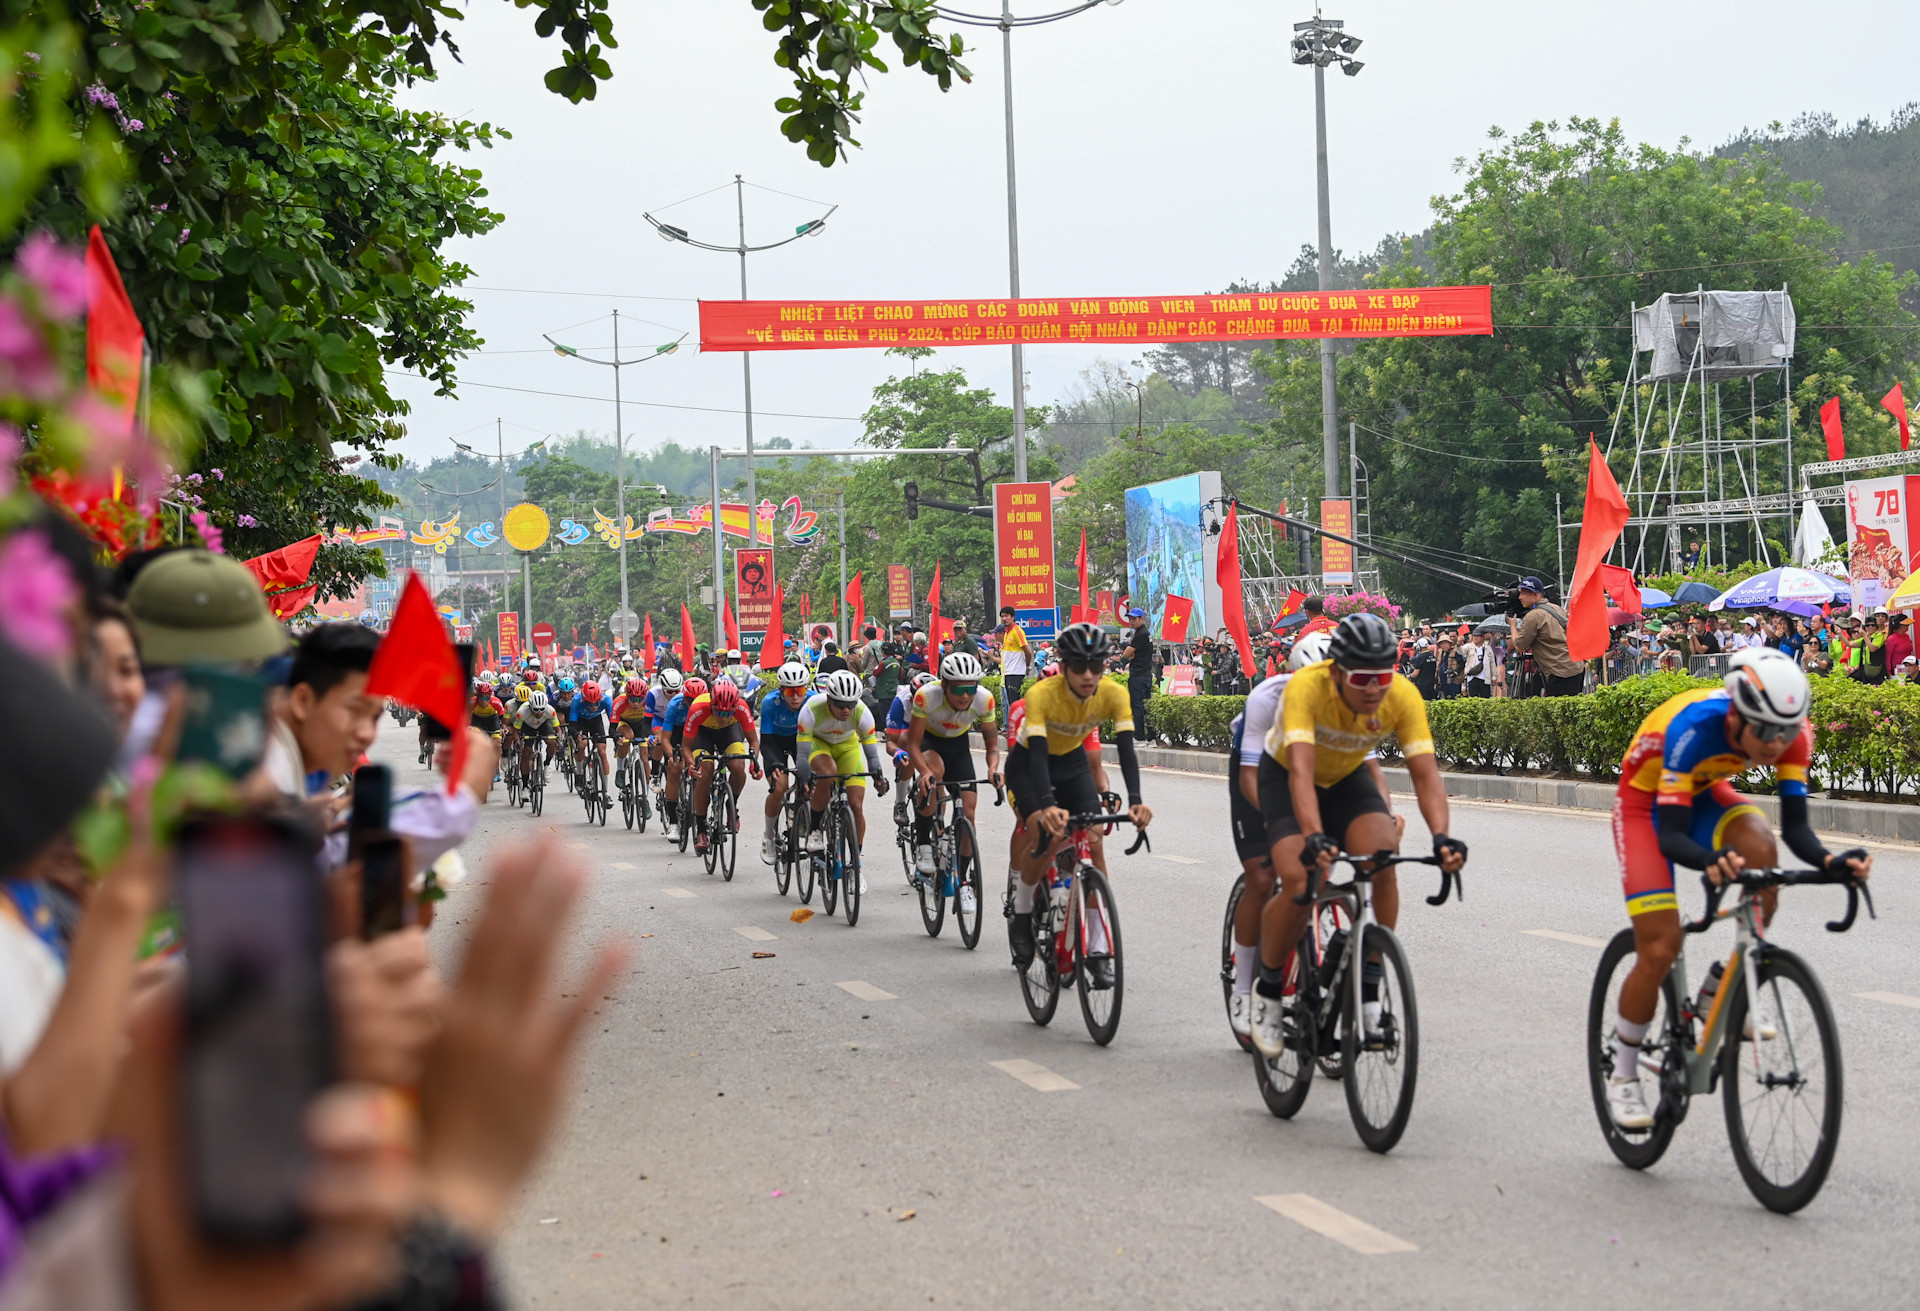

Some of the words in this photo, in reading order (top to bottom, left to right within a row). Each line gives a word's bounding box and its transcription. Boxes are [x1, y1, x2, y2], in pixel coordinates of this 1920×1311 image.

[781, 304, 823, 323] NHIỆT
[835, 304, 864, 322] LIỆT
[924, 303, 968, 319] MỪNG
[977, 302, 1006, 317] CÁC
[1018, 301, 1058, 316] ĐOÀN
[1070, 300, 1100, 317] VẬN
[1109, 299, 1149, 316] ĐỘNG
[1210, 298, 1251, 312] THAM
[1259, 297, 1278, 313] DỰ
[1282, 296, 1320, 313] CUỘC
[1329, 296, 1357, 309] ĐUA
[1368, 296, 1386, 308] XE
[1392, 295, 1420, 311] ĐẠP
[824, 326, 858, 341] BIÊN
[953, 323, 981, 340] CÚP
[987, 323, 1015, 339] BÁO
[1022, 322, 1060, 339] QUÂN
[1069, 321, 1091, 337] ĐỘI
[1097, 320, 1137, 337] NHÂN
[1189, 318, 1216, 335] CÁC
[1227, 317, 1274, 335] CHẶNG
[1283, 319, 1310, 333] ĐUA
[1321, 318, 1342, 334] TẠI
[1352, 314, 1382, 331] TỈNH
[1387, 314, 1419, 332] ĐIỆN
[1012, 491, 1023, 505] CHỦ
[1024, 493, 1036, 506] TỊCH
[1874, 489, 1899, 516] 70
[1007, 509, 1015, 523] HỒ
[1027, 512, 1042, 522] MINH
[1024, 530, 1033, 542] ĐẠI
[1012, 545, 1027, 559] SỐNG
[1028, 546, 1039, 558] MÃI
[1002, 566, 1020, 577] TRONG
[1030, 563, 1050, 578] NGHIỆP
[1005, 582, 1017, 595] CỦA
[1018, 582, 1037, 594] CHÚNG
[1038, 583, 1044, 594] TA
[1733, 596, 1770, 604] vinaphone
[1015, 618, 1052, 628] obifone
[743, 637, 762, 645] BIDV
